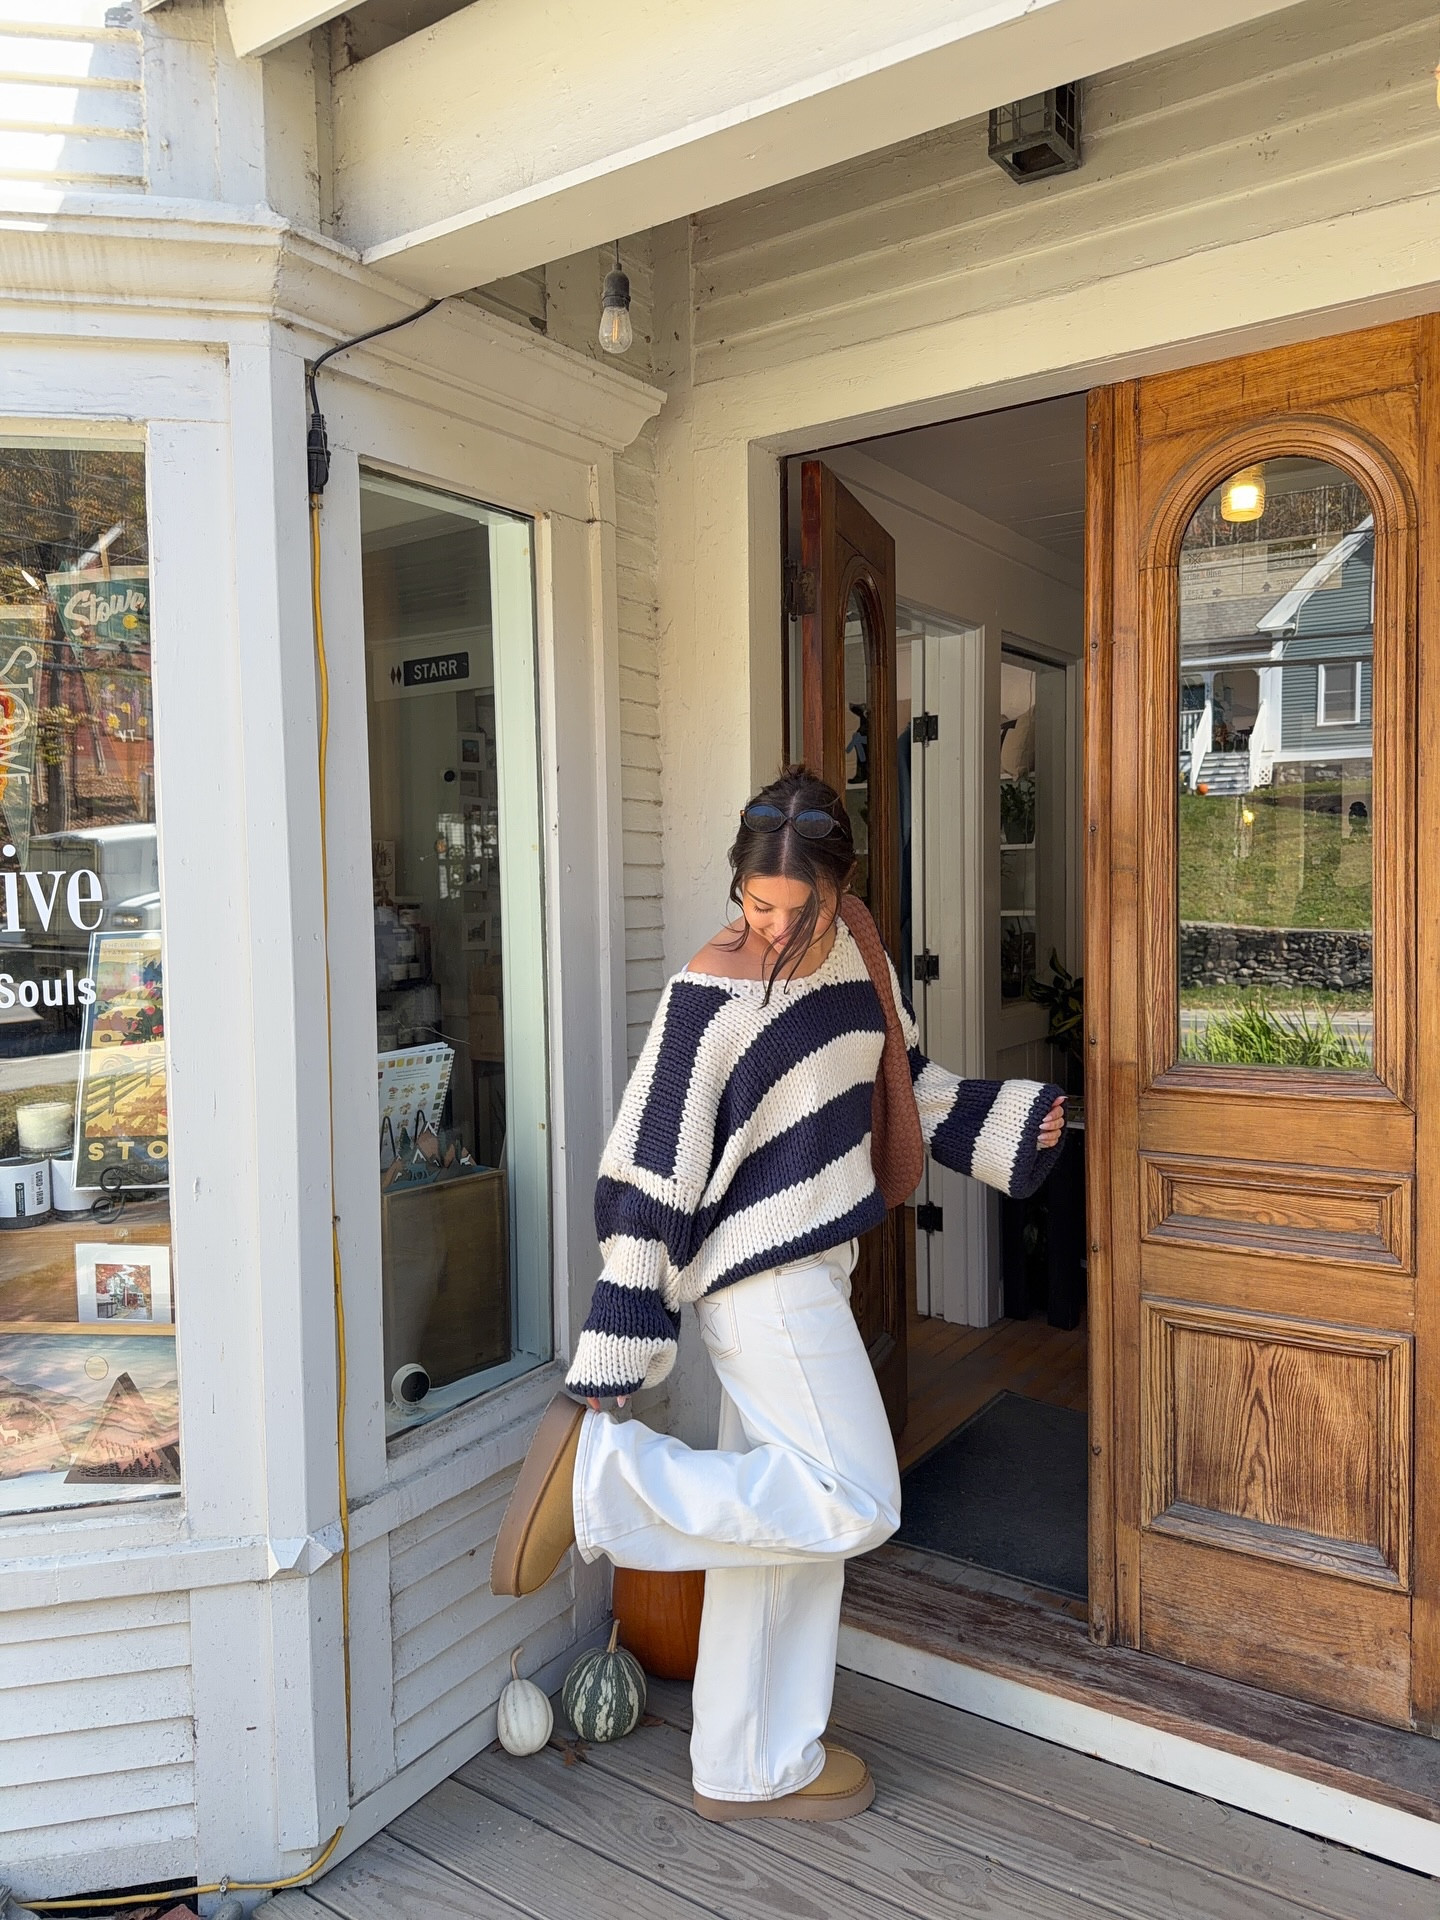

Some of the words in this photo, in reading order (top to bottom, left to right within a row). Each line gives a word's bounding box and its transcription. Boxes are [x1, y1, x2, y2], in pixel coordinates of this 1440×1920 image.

[64, 589, 146, 636] Stowe
[414, 659, 458, 680] STARR
[0, 844, 103, 932] ive
[0, 969, 96, 1008] Souls
[88, 1140, 168, 1161] STO
